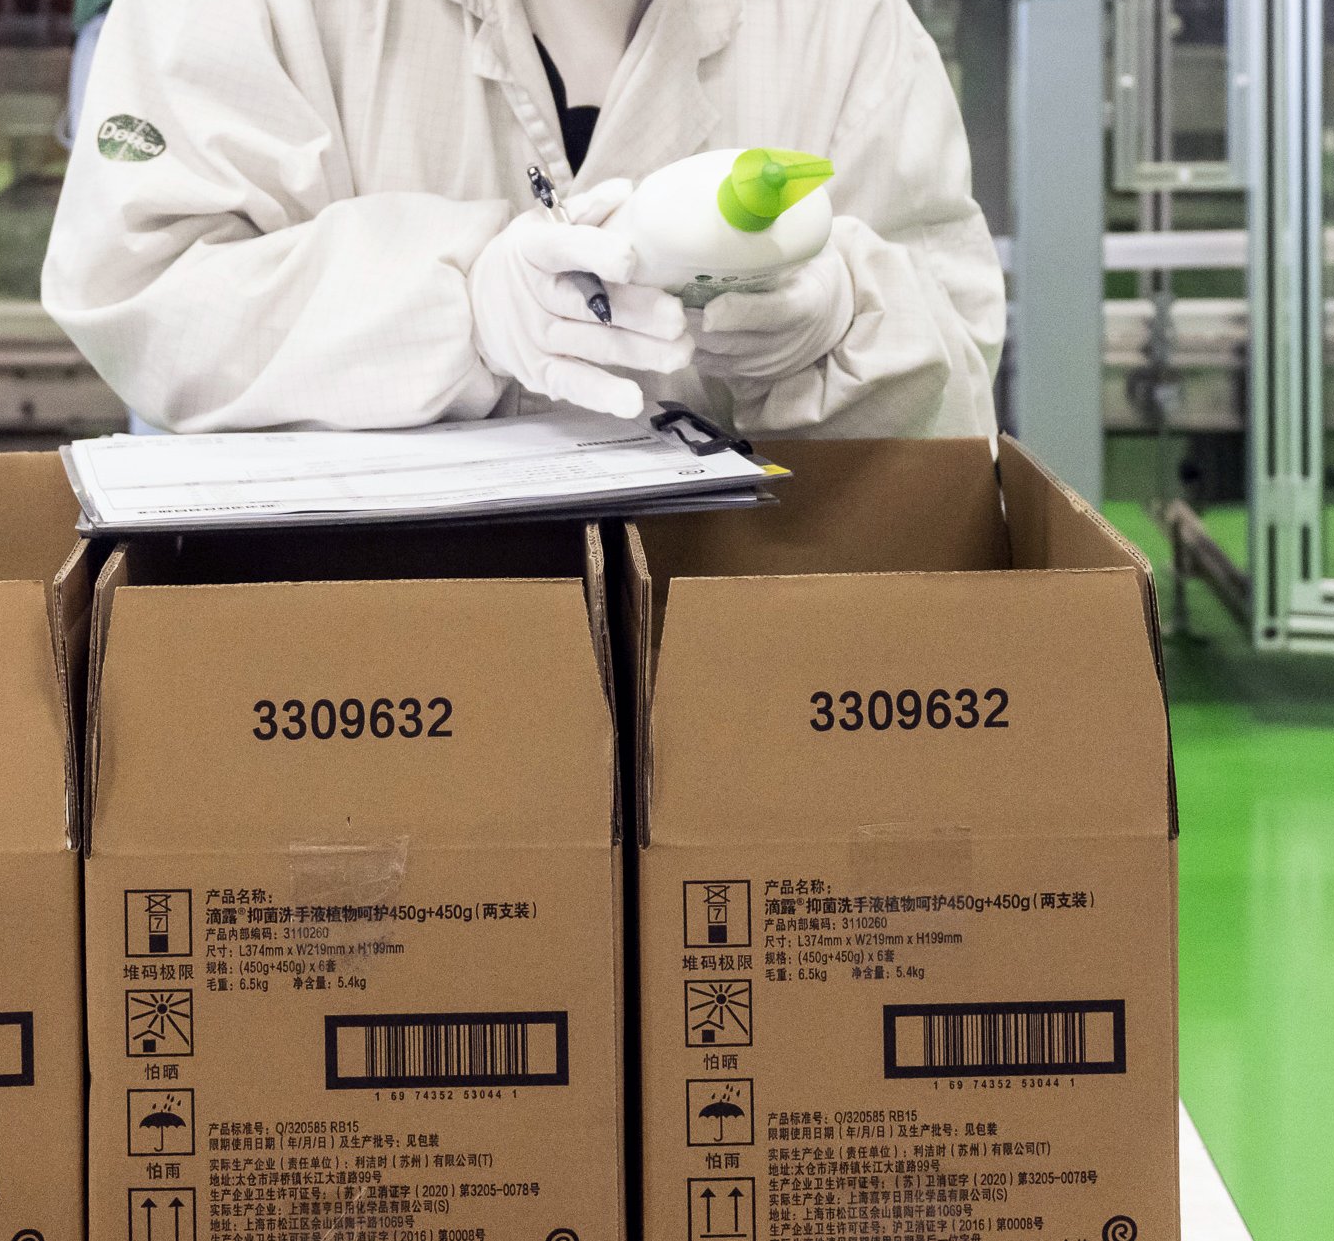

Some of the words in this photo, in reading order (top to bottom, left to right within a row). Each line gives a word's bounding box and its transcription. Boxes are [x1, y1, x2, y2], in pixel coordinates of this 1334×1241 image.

[810, 687, 1009, 731] 3309632
[253, 697, 453, 740] 3309632
[764, 879, 831, 895] 产品名称：
[206, 888, 273, 905] 产品名称：
[713, 908, 721, 920] 7
[154, 917, 162, 929] 7
[855, 934, 903, 946] W219mm
[917, 932, 963, 945] H199mm
[297, 943, 344, 956] W219mm
[358, 942, 404, 955] H199mm
[683, 955, 753, 971] 堆码极限
[124, 964, 194, 981] 堆码极限
[703, 1054, 738, 1071] 怕晒
[144, 1063, 179, 1081] 怕晒
[950, 1080, 963, 1089] 69
[974, 1079, 1011, 1089] 74352
[1022, 1078, 1059, 1088] 53044
[391, 1091, 405, 1101] 69
[416, 1090, 453, 1100] 74352
[464, 1090, 502, 1099] 53044
[889, 1110, 917, 1122] RB15
[330, 1121, 359, 1133] RB15
[706, 1152, 740, 1170] 怕雨
[146, 1163, 181, 1180] 怕雨
